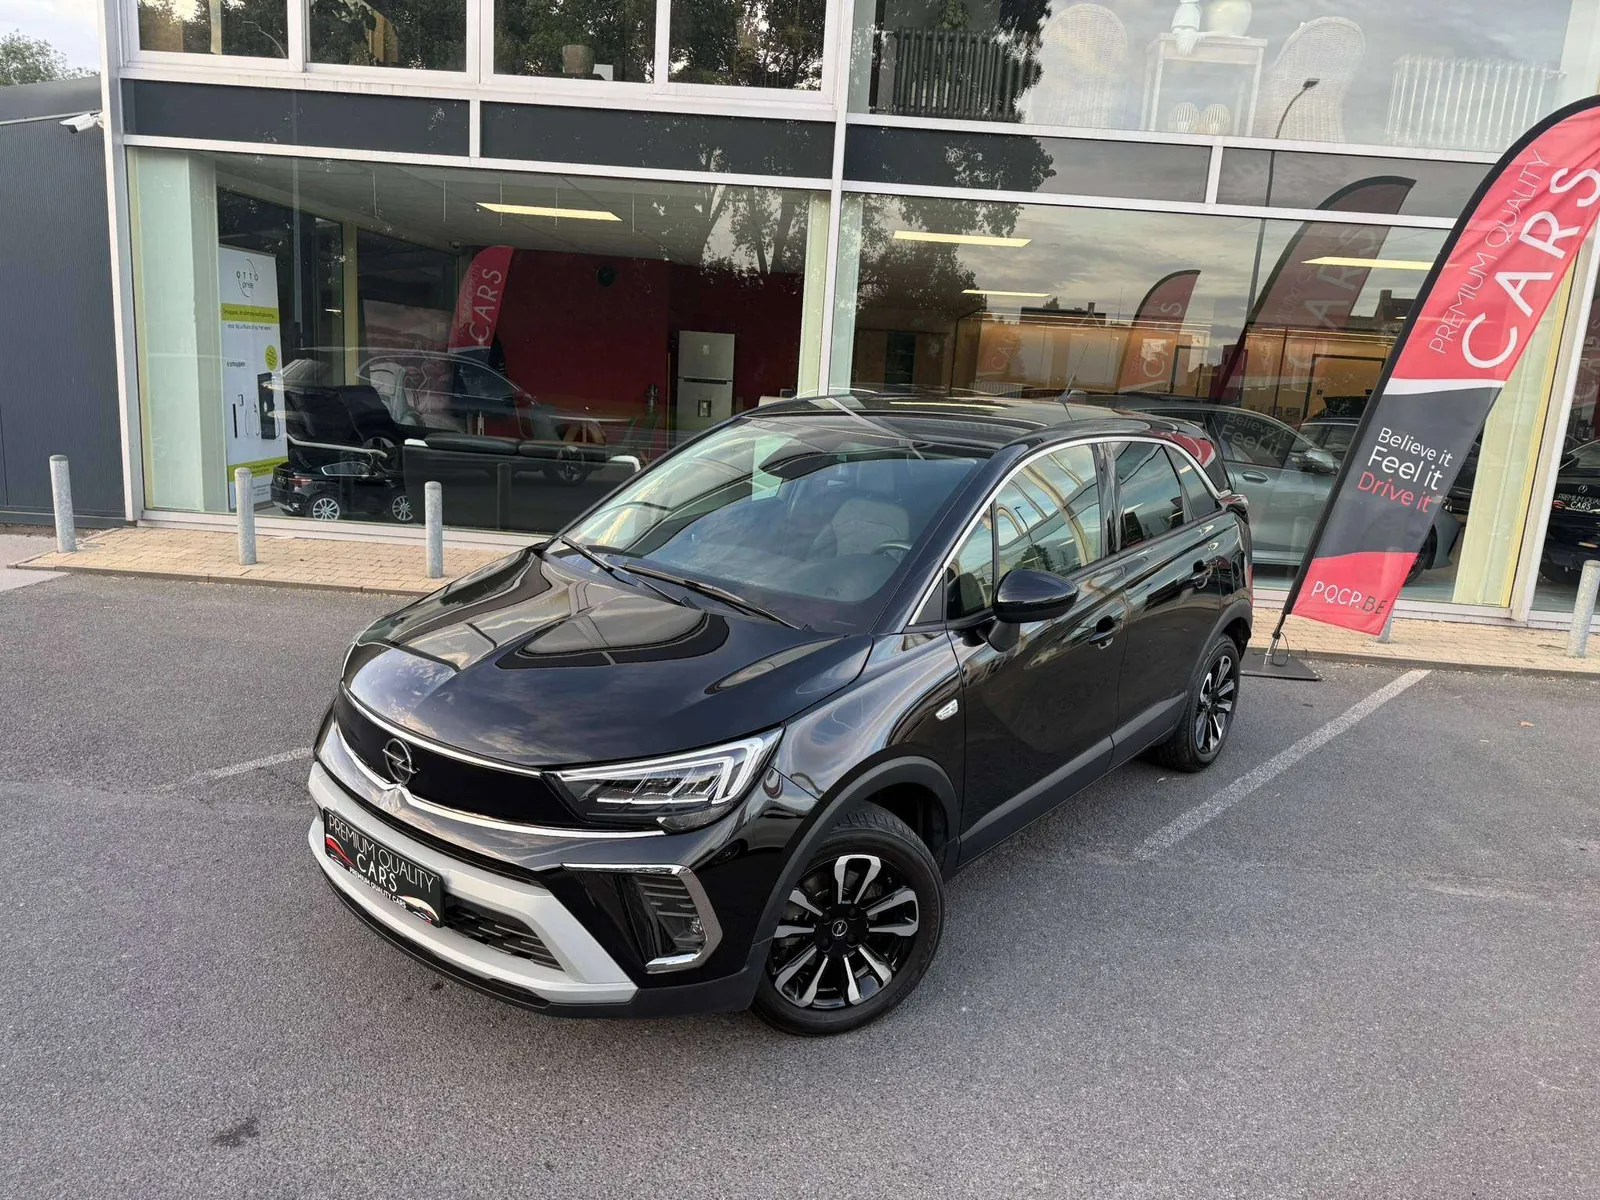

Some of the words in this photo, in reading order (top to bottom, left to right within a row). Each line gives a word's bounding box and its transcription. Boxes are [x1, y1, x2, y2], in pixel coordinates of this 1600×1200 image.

[1429, 252, 1498, 355] PREMIUM
[1485, 149, 1550, 245] QUALITY
[1462, 167, 1600, 369] CARS
[236, 271, 259, 281] OTTO
[469, 268, 502, 342] CARS
[1220, 424, 1265, 450] Feel
[1378, 427, 1436, 461] Believe
[1438, 450, 1454, 468] it
[1367, 446, 1424, 483] Feel
[1424, 465, 1444, 490] it
[1357, 471, 1414, 506] Drive
[1416, 491, 1433, 513] it
[1570, 501, 1591, 510] CARS
[328, 814, 376, 861] PREMIUM
[378, 849, 434, 893] QUALITY
[356, 853, 397, 892] CARS
